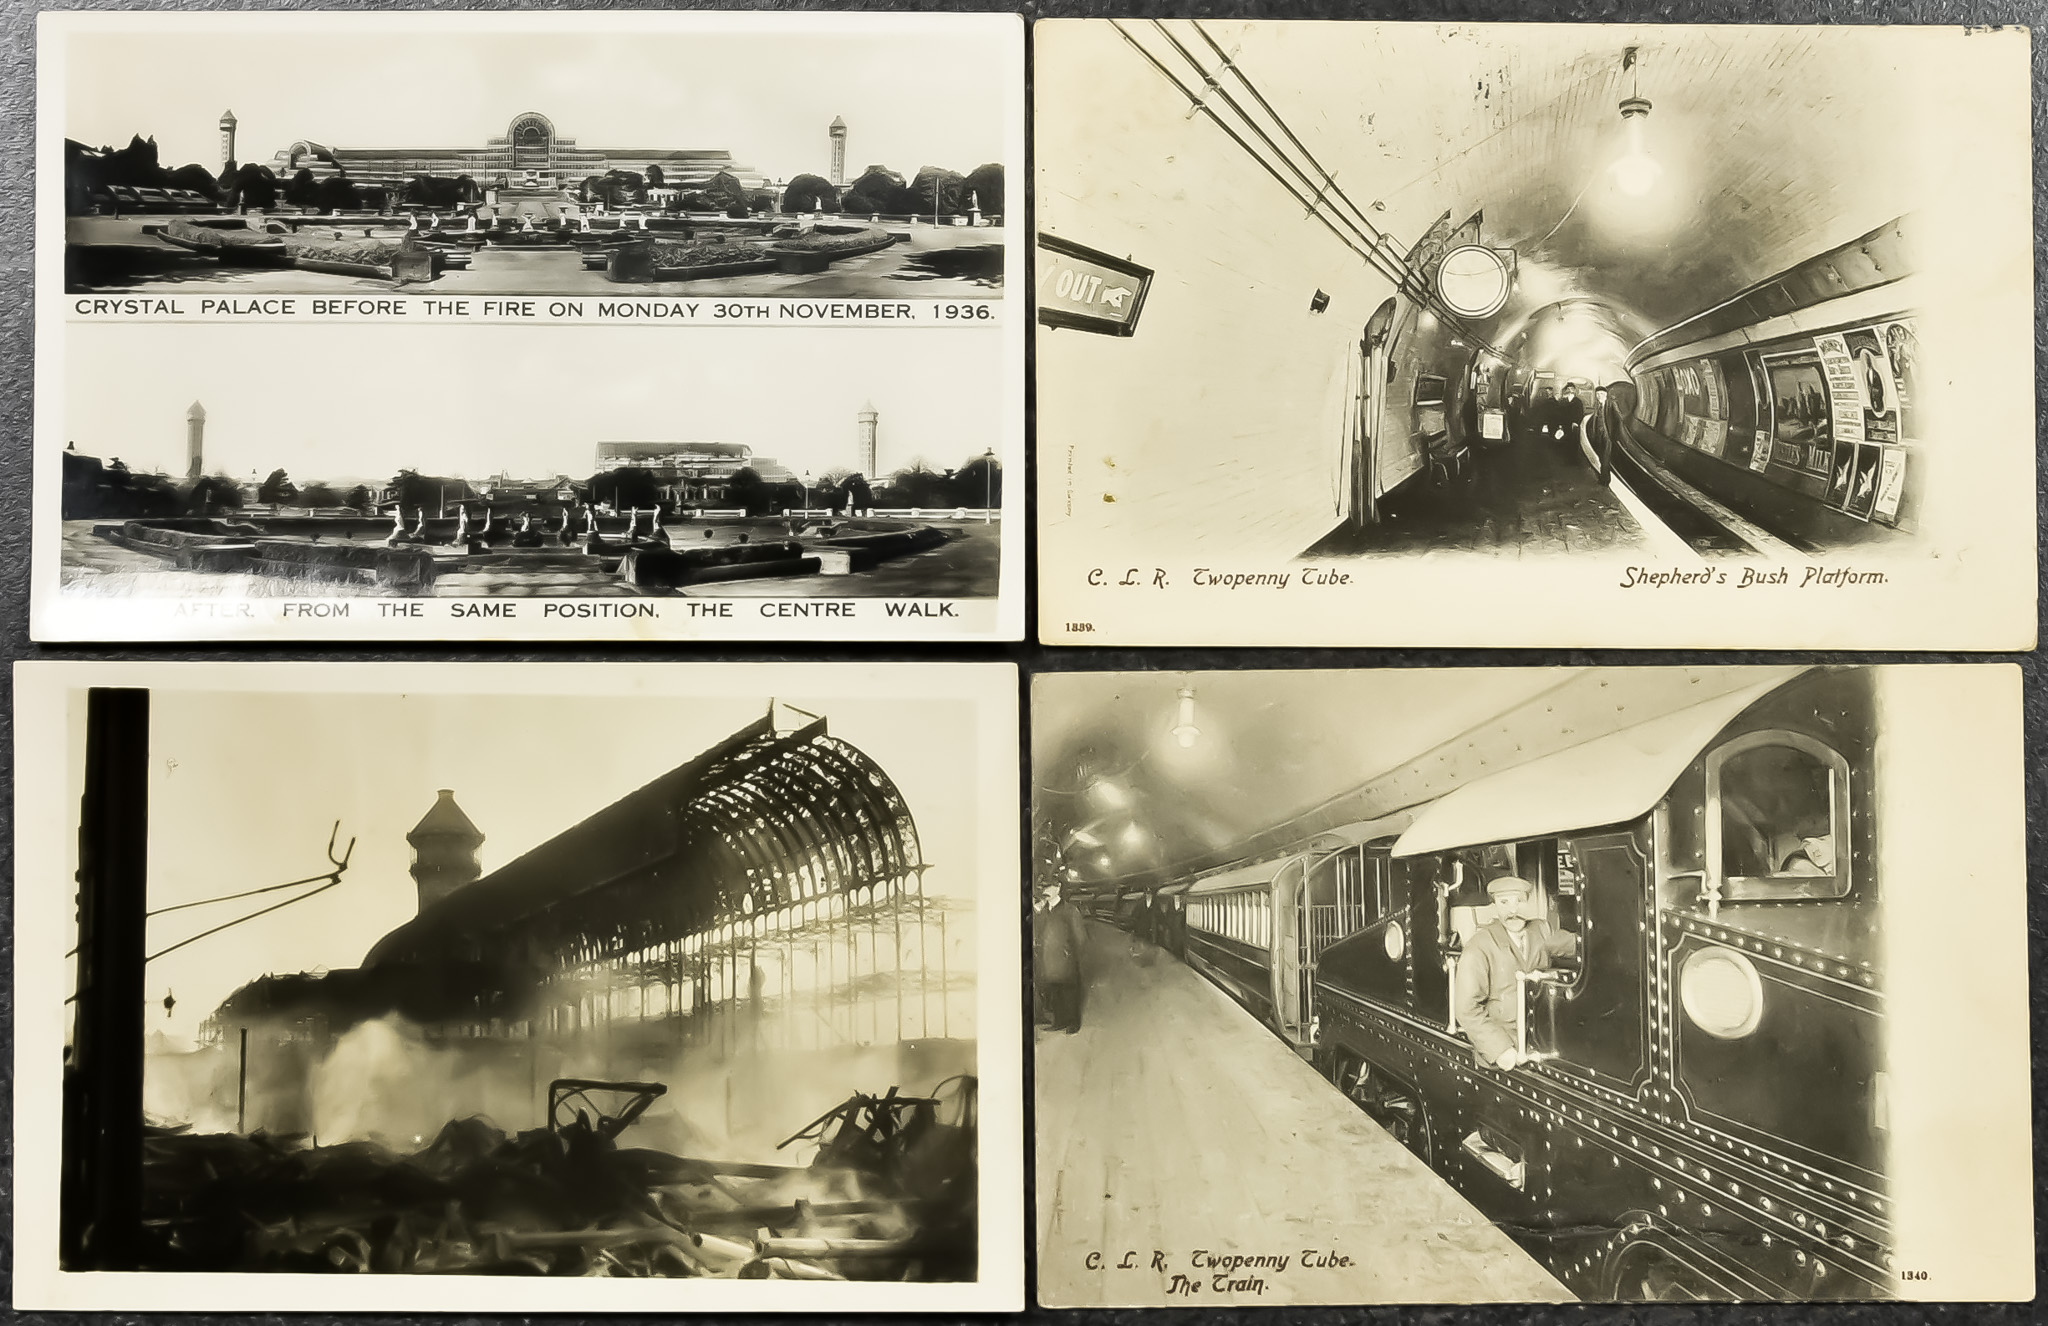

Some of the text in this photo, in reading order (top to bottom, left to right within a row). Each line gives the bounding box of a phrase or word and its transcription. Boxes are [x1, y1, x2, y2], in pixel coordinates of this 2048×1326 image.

[1055, 269, 1103, 304] OUT
[75, 299, 995, 320] CRYSTAL PALACE BEFORE THE FIRE ON MONDAY 30TH NOVEMBER, 1936.
[1087, 568, 1354, 590] C. L. R. Twopenny Tube.
[1619, 566, 1889, 589] Shepherd's Bush Platform.
[282, 602, 350, 618] FROM
[377, 602, 425, 618] THE
[450, 602, 517, 619] SAME
[543, 602, 660, 619] POSITION,
[686, 602, 734, 618] THE
[759, 602, 856, 618] CENTRE
[885, 602, 960, 618] WALK.
[1085, 1251, 1106, 1271] C.
[1116, 1250, 1139, 1270] L.
[1192, 1249, 1290, 1273] Twopenny
[1300, 1249, 1356, 1269] Tube.
[1166, 1273, 1270, 1297] The Train.
